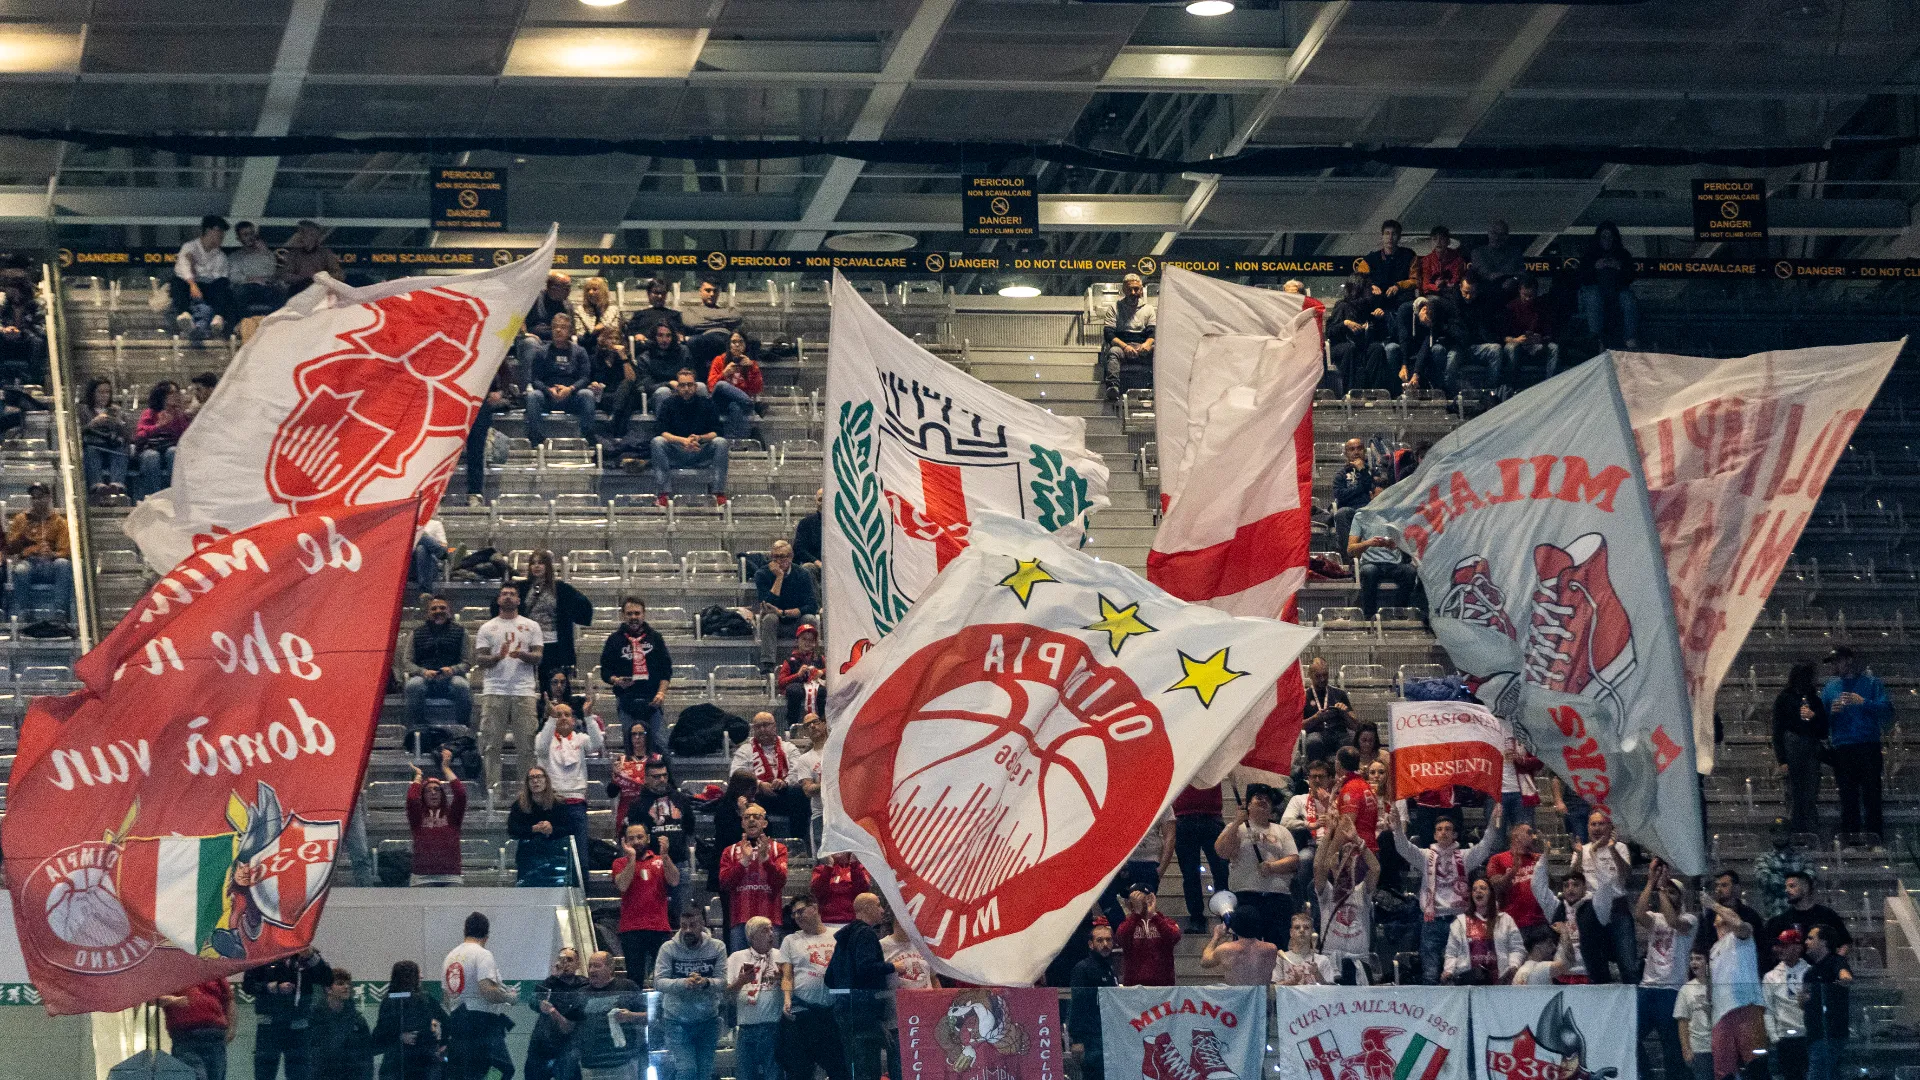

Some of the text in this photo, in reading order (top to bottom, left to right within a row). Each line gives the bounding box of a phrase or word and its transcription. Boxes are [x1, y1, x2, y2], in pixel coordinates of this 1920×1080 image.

[973, 178, 1025, 187] PERICOLO!
[1703, 182, 1753, 191] PERICOLO!
[979, 216, 1022, 225] DANGER!
[1709, 220, 1752, 228] DANGER!
[77, 253, 179, 263] DANGER! DO NO
[372, 253, 474, 264] NON SCAVALCARE
[583, 255, 697, 265] DO NOT CLIMB OVER
[731, 255, 791, 266] PERICOLO!
[806, 256, 907, 268] NON SCAVALCARE
[950, 259, 999, 269] DANGER!
[1015, 259, 1126, 270] DO NOT CLIMB OVER
[1235, 261, 1334, 272] NON SCAVALCARE
[1659, 263, 1756, 274] NON SCAVALCARE
[1797, 266, 1846, 276] DANGER!
[1860, 267, 1876, 276] DO
[1879, 267, 1902, 277] NOT
[1408, 757, 1493, 778] PRESENTI
[1129, 998, 1239, 1033] MILANO
[1289, 998, 1459, 1037] CURVA MILANO 1936
[1304, 1050, 1343, 1071] 1936
[1489, 1051, 1559, 1080] 1936
